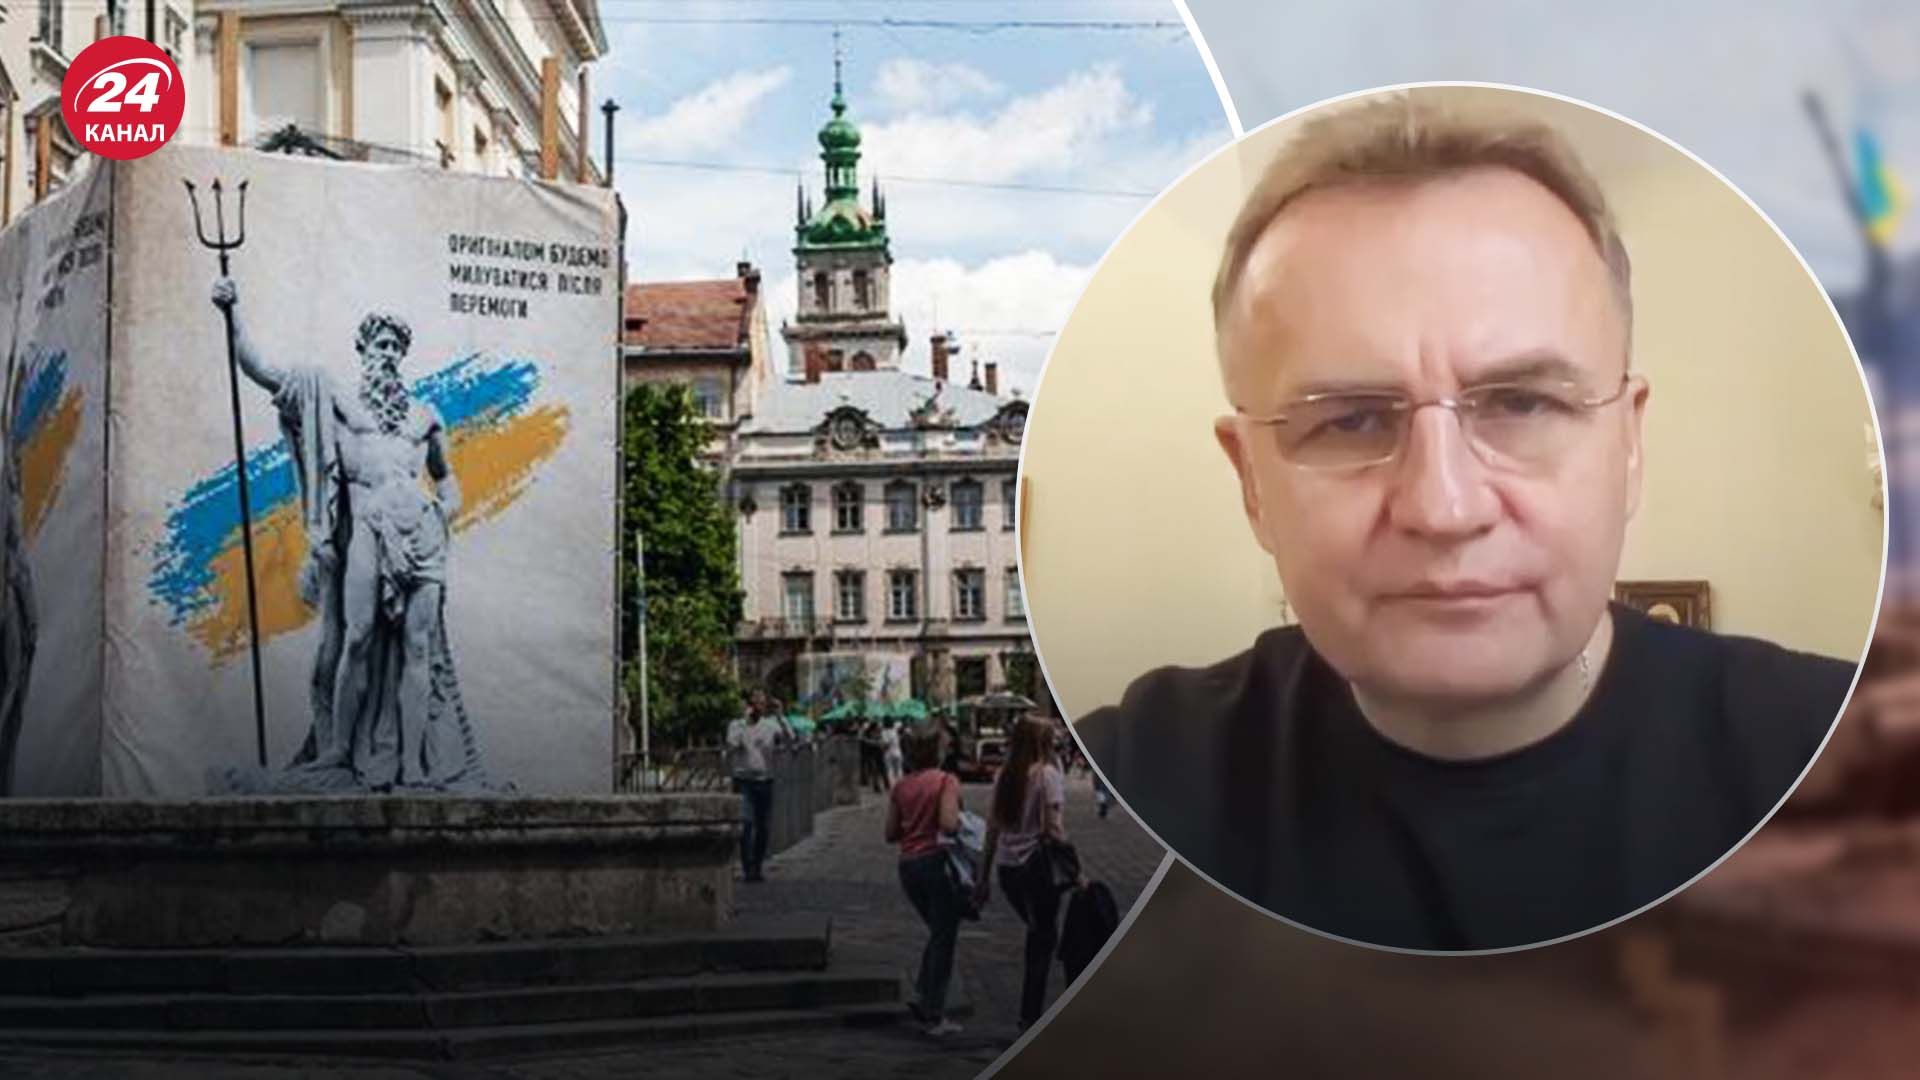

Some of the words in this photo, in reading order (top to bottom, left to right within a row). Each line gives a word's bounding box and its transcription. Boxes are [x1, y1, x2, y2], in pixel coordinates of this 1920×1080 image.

[448, 234, 544, 262] ОРИГІНАЛОМ
[550, 243, 609, 268] БУДЕМО
[450, 264, 548, 292] МИЛУВАТИСЯ
[558, 273, 602, 295] ПІСЛЯ
[450, 293, 528, 318] ПЕРЕМОГИ
